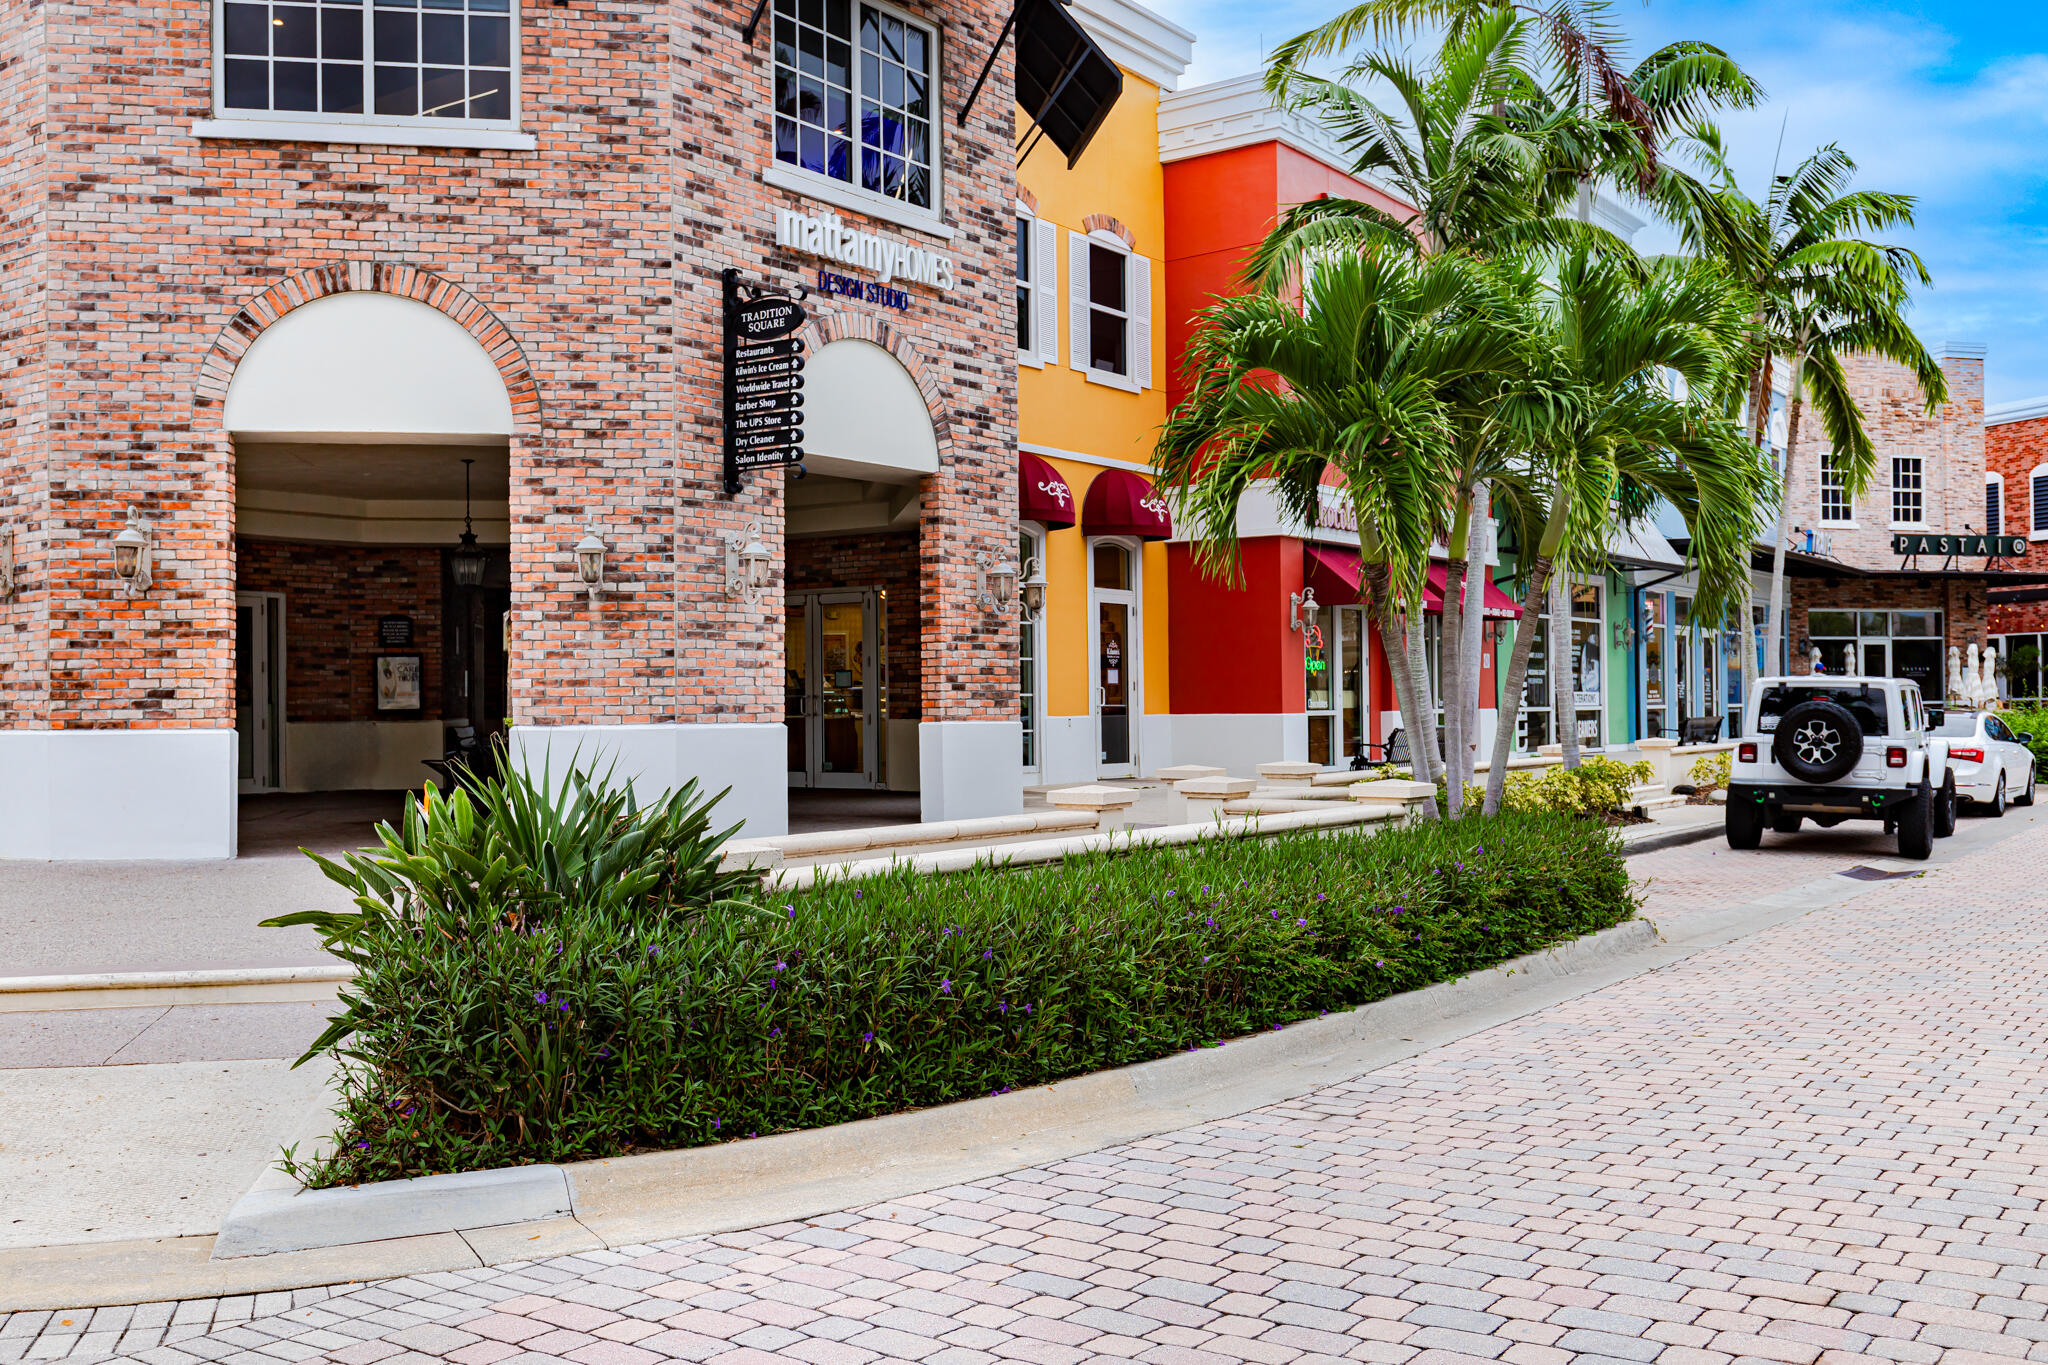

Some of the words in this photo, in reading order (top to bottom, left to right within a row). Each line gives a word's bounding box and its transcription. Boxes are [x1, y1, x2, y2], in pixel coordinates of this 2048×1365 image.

[818, 270, 865, 300] DESIGN
[866, 283, 909, 311] STUDIO
[741, 305, 793, 322] TRADITION
[748, 317, 786, 333] SQUARE
[735, 346, 775, 358] Restaurants
[735, 365, 758, 376] Kilwin's
[758, 364, 768, 372] Ice
[768, 362, 789, 372] Cream
[736, 381, 771, 393] Worldwide
[771, 377, 790, 389] Travel
[735, 400, 758, 411] Barber
[759, 398, 777, 408] Shop
[735, 420, 748, 428] The
[749, 417, 763, 427] UPS
[764, 416, 782, 425] Store
[735, 437, 749, 447] Dry
[749, 435, 775, 445] Cleaner
[735, 453, 755, 464] Salon
[757, 450, 784, 462] Identity
[1900, 536, 2026, 554] PASTAIO
[1305, 656, 1325, 674] Open
